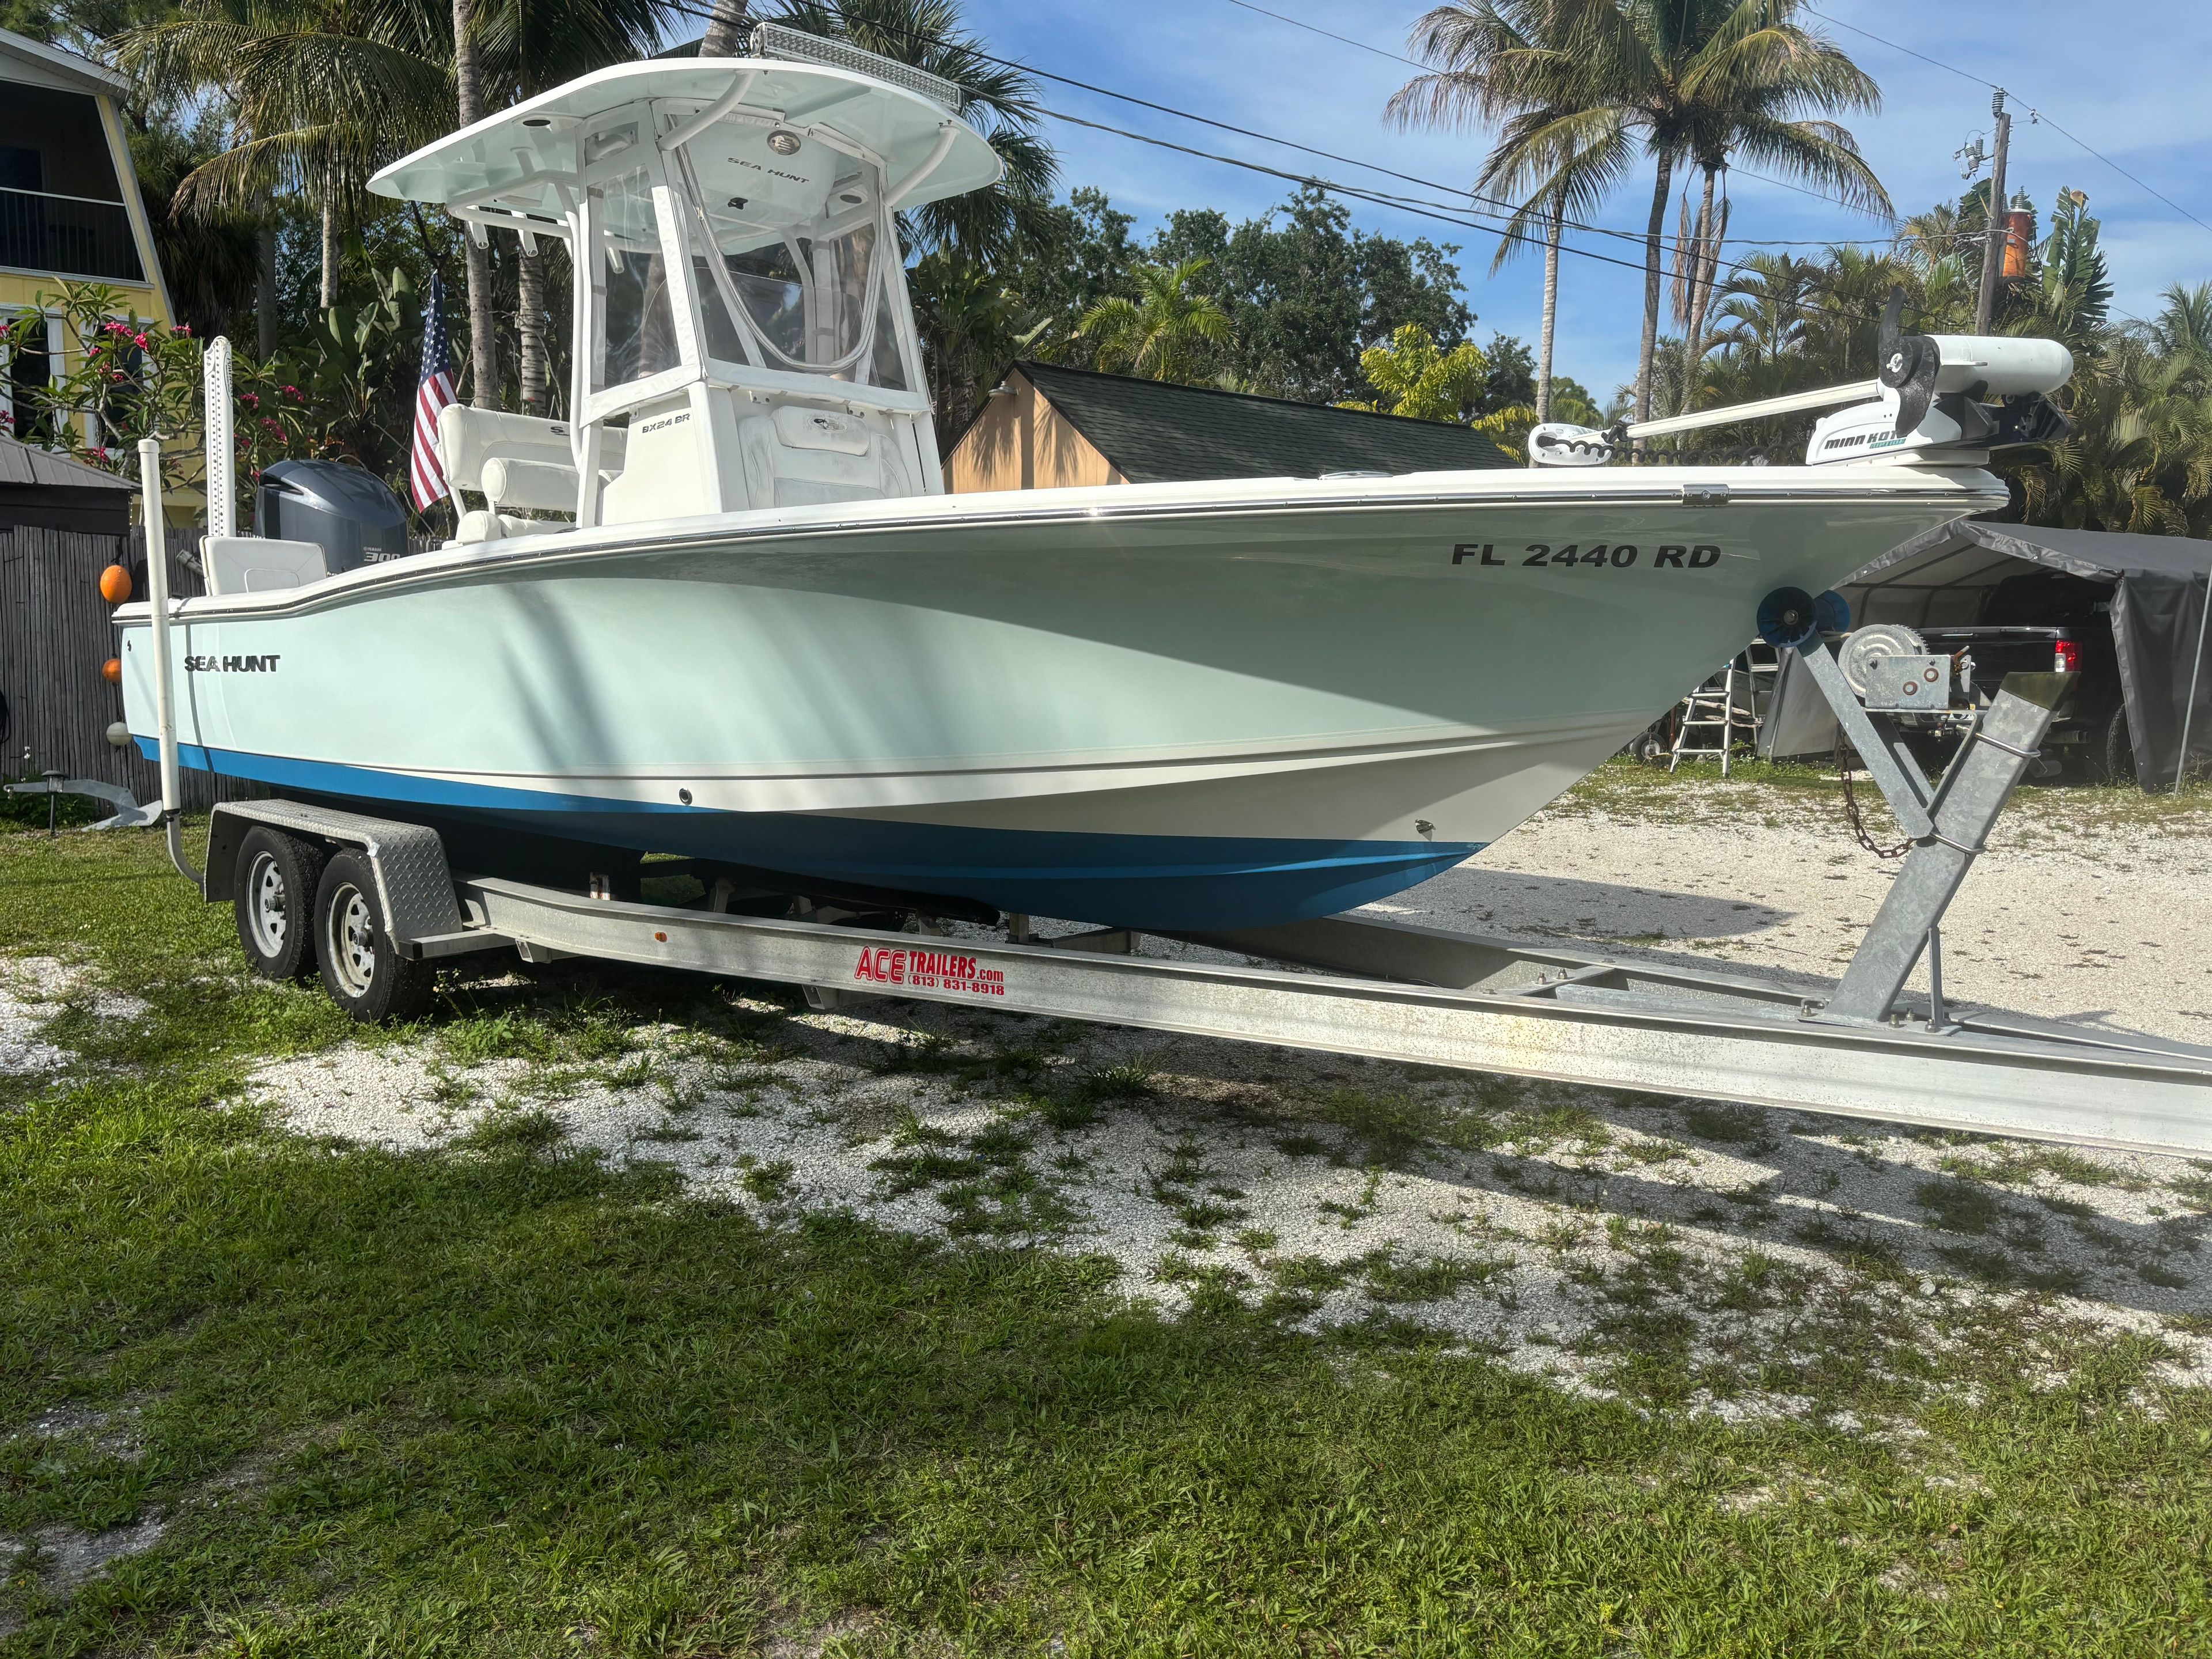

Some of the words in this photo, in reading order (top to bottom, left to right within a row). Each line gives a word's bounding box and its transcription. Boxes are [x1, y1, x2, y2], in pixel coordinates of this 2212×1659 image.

[727, 157, 762, 171] SEA
[767, 169, 809, 183] HUNT
[642, 418, 673, 433] BX24
[675, 413, 690, 424] BR
[1824, 434, 1866, 450] MINN
[1866, 430, 1897, 444] KOT
[363, 552, 401, 562] 300
[1451, 544, 1506, 566] FL
[1521, 544, 1638, 567] 2440
[1653, 545, 1721, 568] RD
[184, 656, 221, 672] SEA
[222, 654, 281, 672] HUNT
[854, 946, 907, 984] ACE
[908, 975, 940, 988] (813)
[944, 979, 1005, 995] 831-8918
